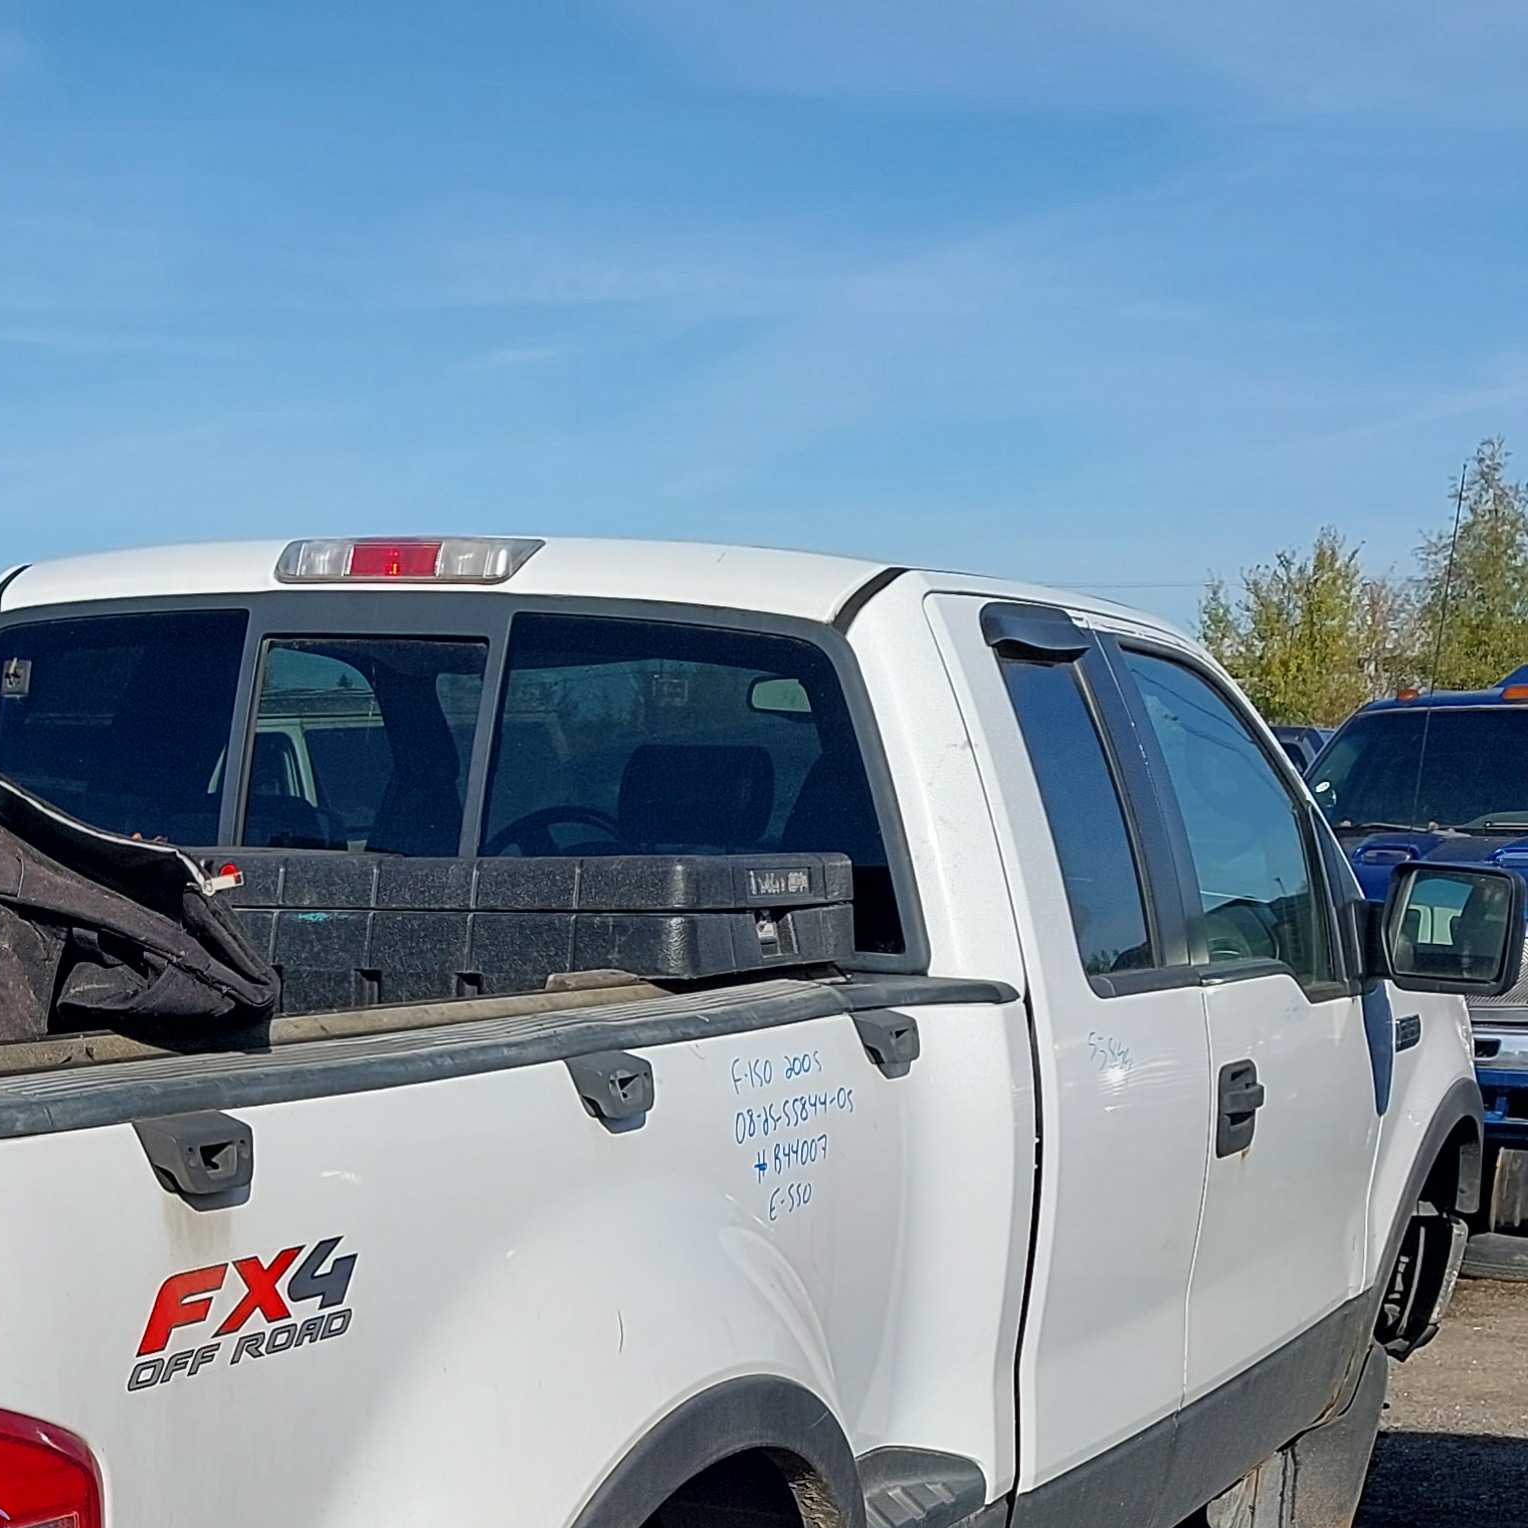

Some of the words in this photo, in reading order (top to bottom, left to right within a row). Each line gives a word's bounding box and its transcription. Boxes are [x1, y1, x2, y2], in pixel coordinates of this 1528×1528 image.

[783, 1050, 823, 1080] 2005
[136, 1235, 359, 1358] FX4
[127, 1342, 222, 1392] OFF
[229, 1308, 353, 1366] ROAD
